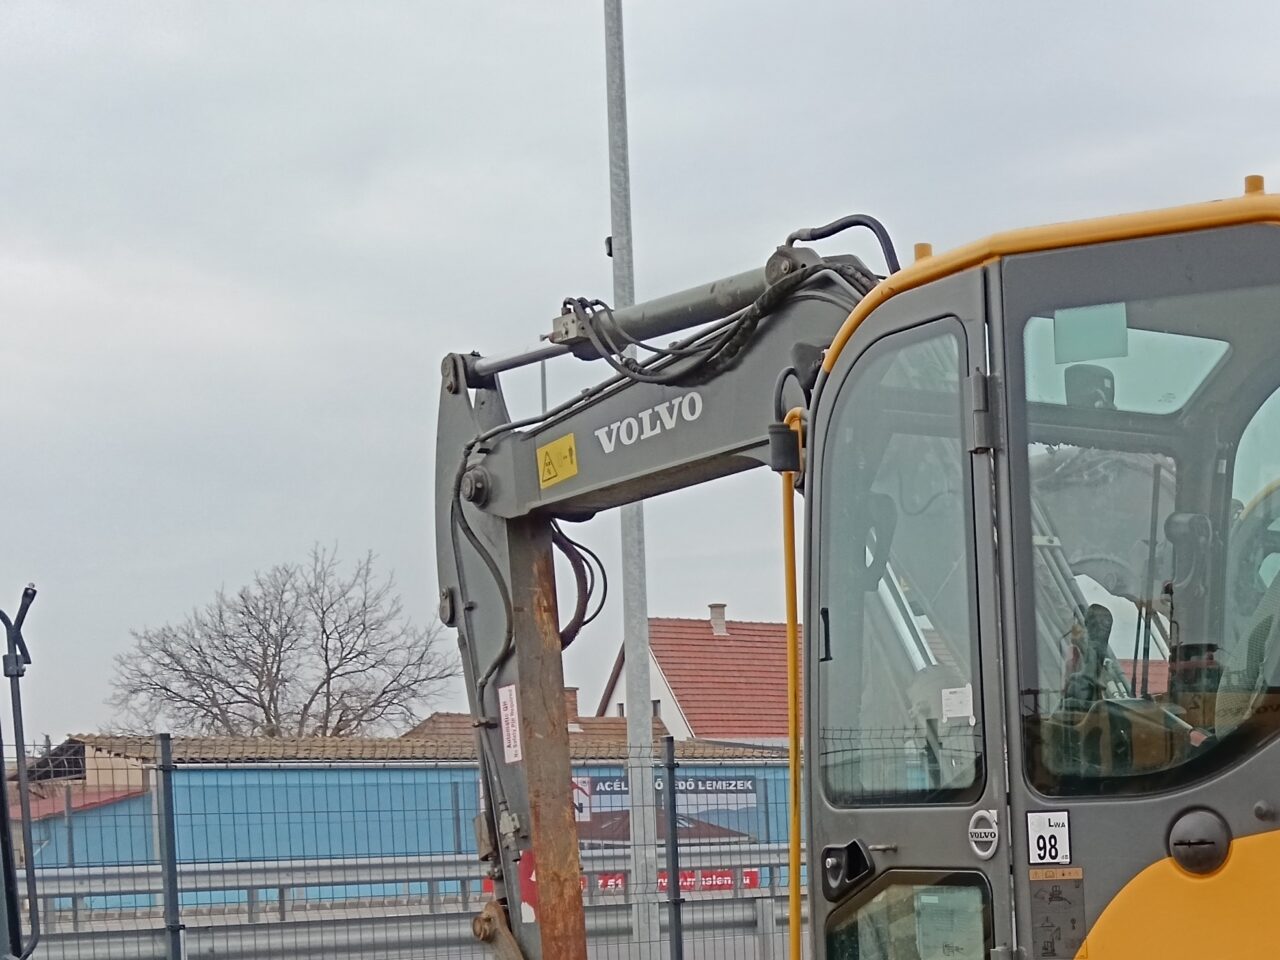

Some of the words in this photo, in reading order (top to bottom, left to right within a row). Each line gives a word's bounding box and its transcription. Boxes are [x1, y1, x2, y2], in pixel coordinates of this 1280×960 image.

[594, 391, 703, 454] VOLVO
[596, 779, 628, 791] ACÉL
[698, 780, 752, 790] LEMEZEK
[969, 831, 997, 840] VOLVO
[1036, 834, 1059, 860] 98
